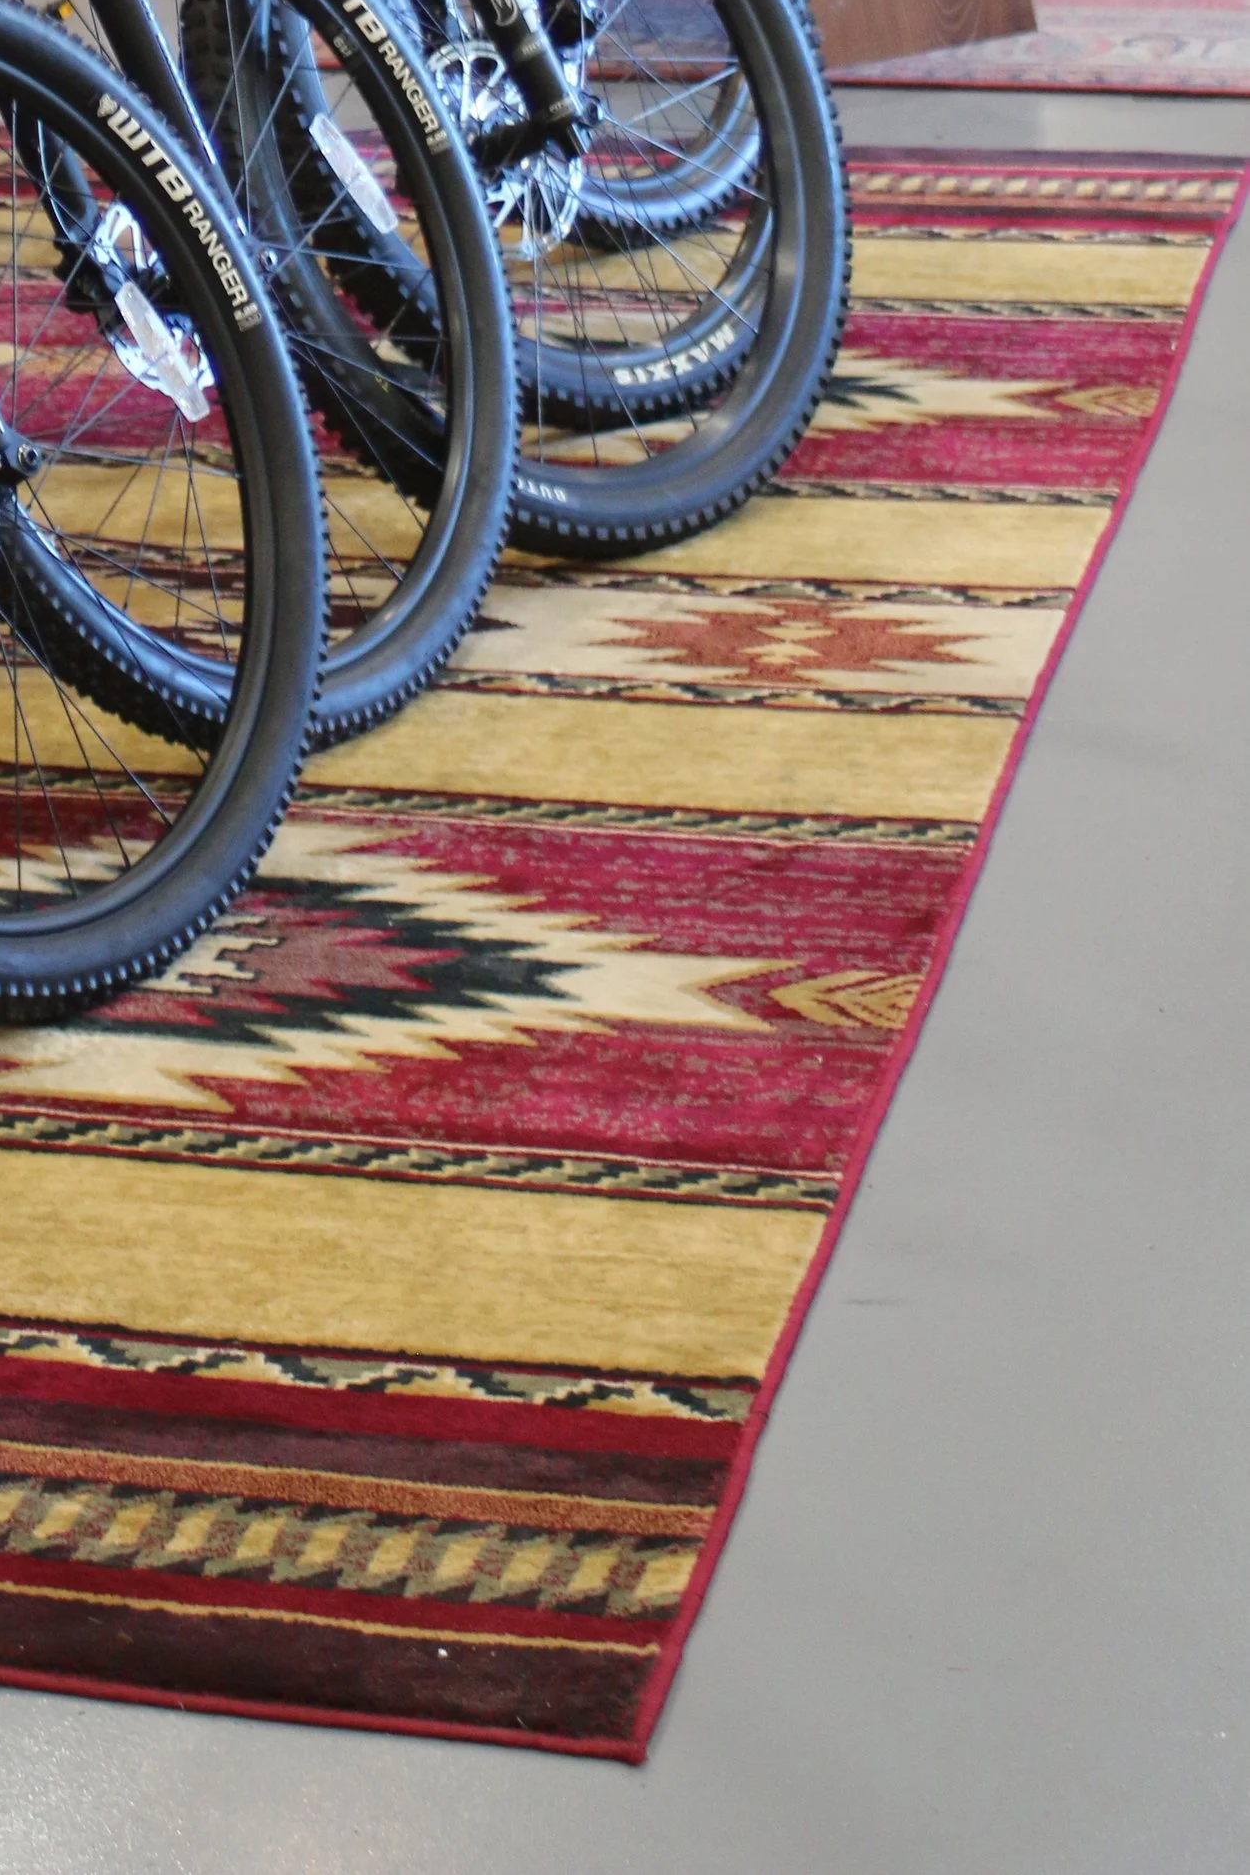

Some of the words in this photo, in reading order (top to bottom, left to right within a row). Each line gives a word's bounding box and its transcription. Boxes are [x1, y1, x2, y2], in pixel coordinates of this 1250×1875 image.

[377, 41, 440, 134] RANGER
[106, 104, 194, 203] WTB
[181, 198, 249, 308] RANGER
[613, 323, 737, 386] MAXXIS
